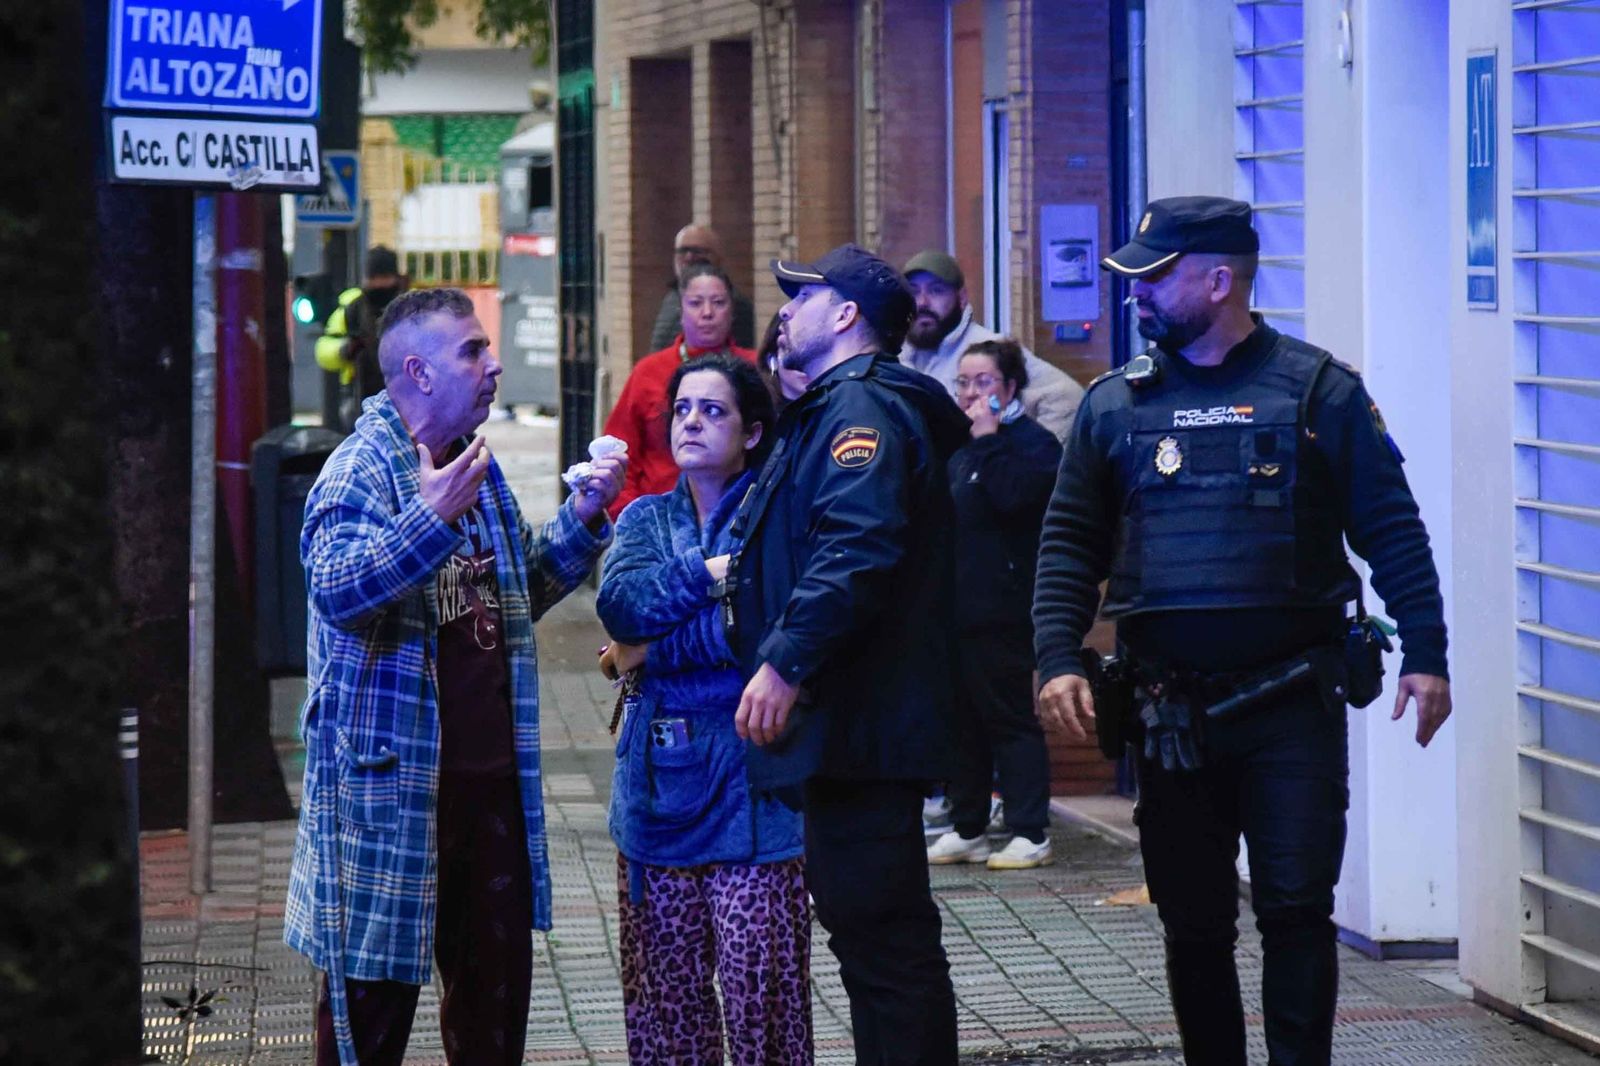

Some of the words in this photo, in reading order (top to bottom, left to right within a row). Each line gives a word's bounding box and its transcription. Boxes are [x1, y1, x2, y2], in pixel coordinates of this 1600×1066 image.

[127, 7, 254, 49] TRIANA
[125, 57, 309, 102] ALTOZANO
[204, 133, 313, 172] CASTILLA
[1174, 414, 1253, 427] NACIONAL
[841, 449, 869, 462] POLICIA
